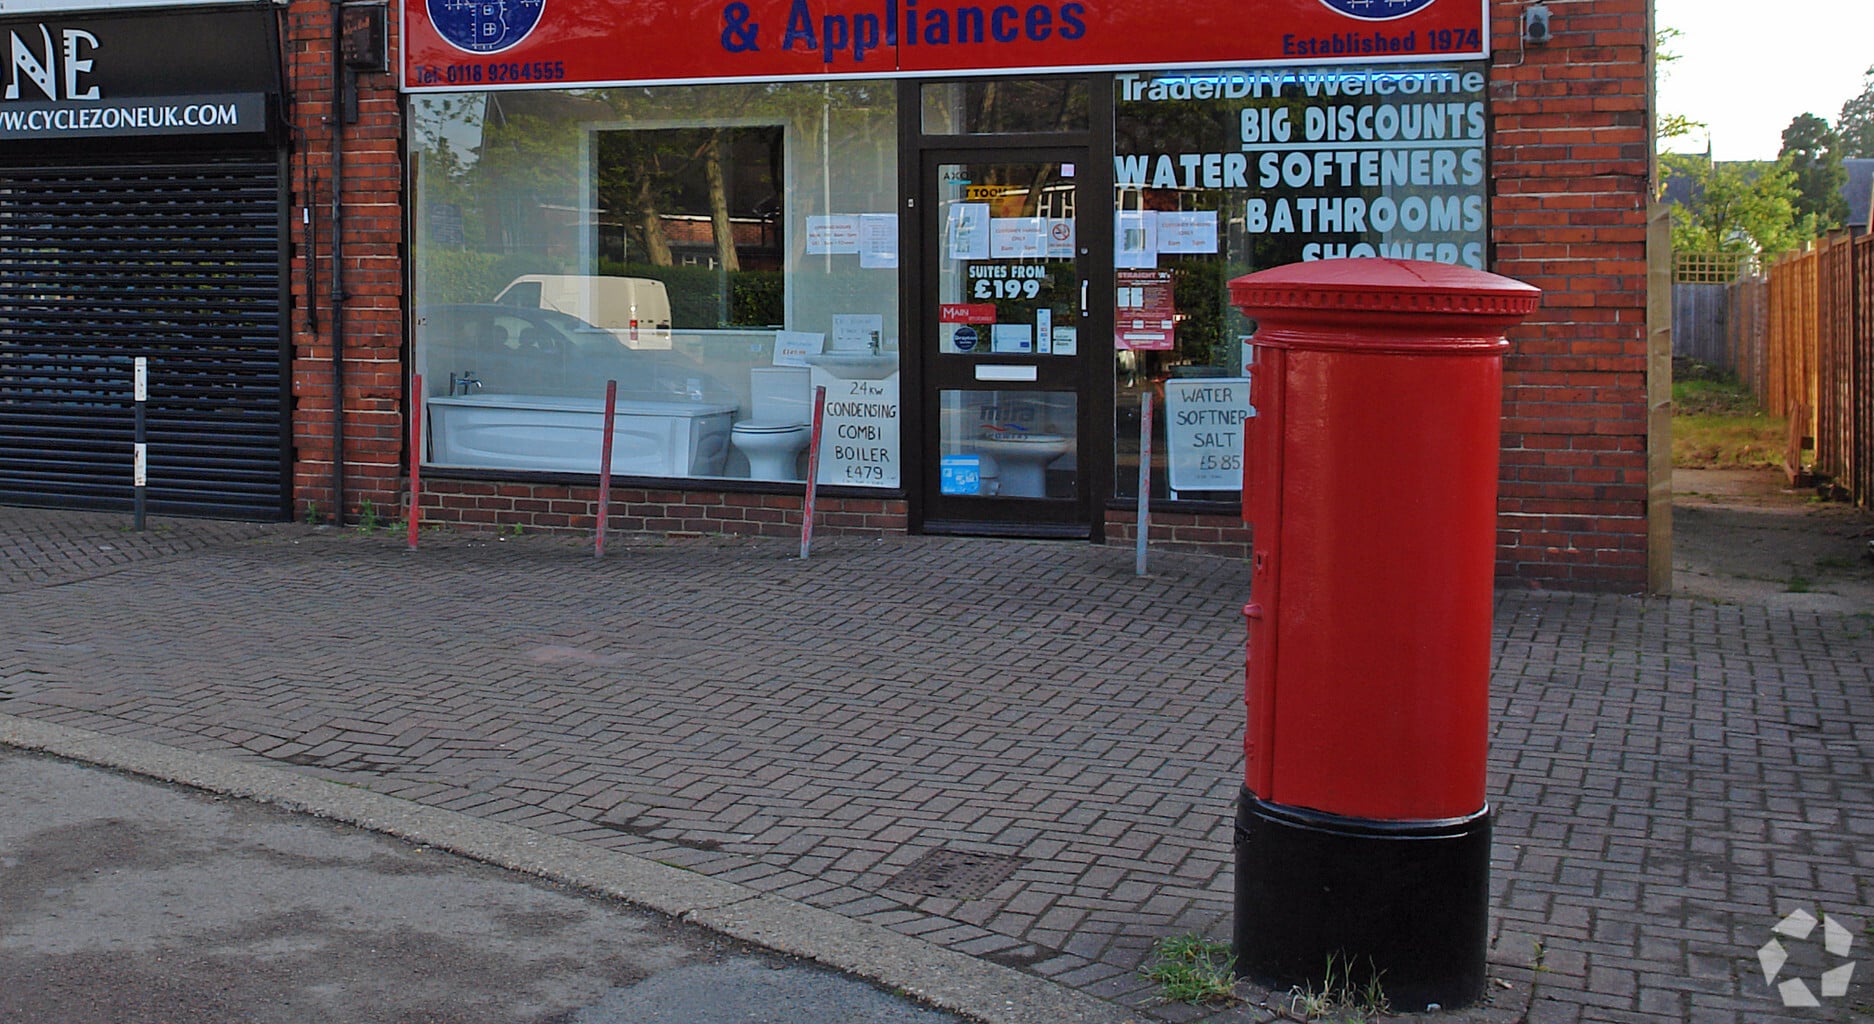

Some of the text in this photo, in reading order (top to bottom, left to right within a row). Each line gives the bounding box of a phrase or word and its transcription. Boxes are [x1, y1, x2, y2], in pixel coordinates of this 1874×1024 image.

[720, 1, 760, 53] &
[1283, 29, 1480, 55] Established 1974
[447, 64, 482, 83] 0118
[488, 61, 564, 81] 9264555
[1115, 67, 1485, 101] Trade/DIY Welcome
[0, 104, 238, 130] W.CYCLEZONEUK.COM
[1240, 102, 1485, 143] BIG DISCOUNTS
[1115, 149, 1484, 189] WATER SOFTENERS
[1246, 195, 1483, 233] BATHROOMS
[969, 265, 1046, 278] SUITES FROM
[973, 279, 1040, 299] £199
[1181, 388, 1233, 403] WATER
[826, 402, 897, 418] CONDENSING
[1177, 409, 1248, 426] SOFTNER
[838, 424, 881, 440] COMBI
[1193, 432, 1236, 448] SALT
[835, 446, 890, 463] BOILER
[846, 465, 883, 480] £479
